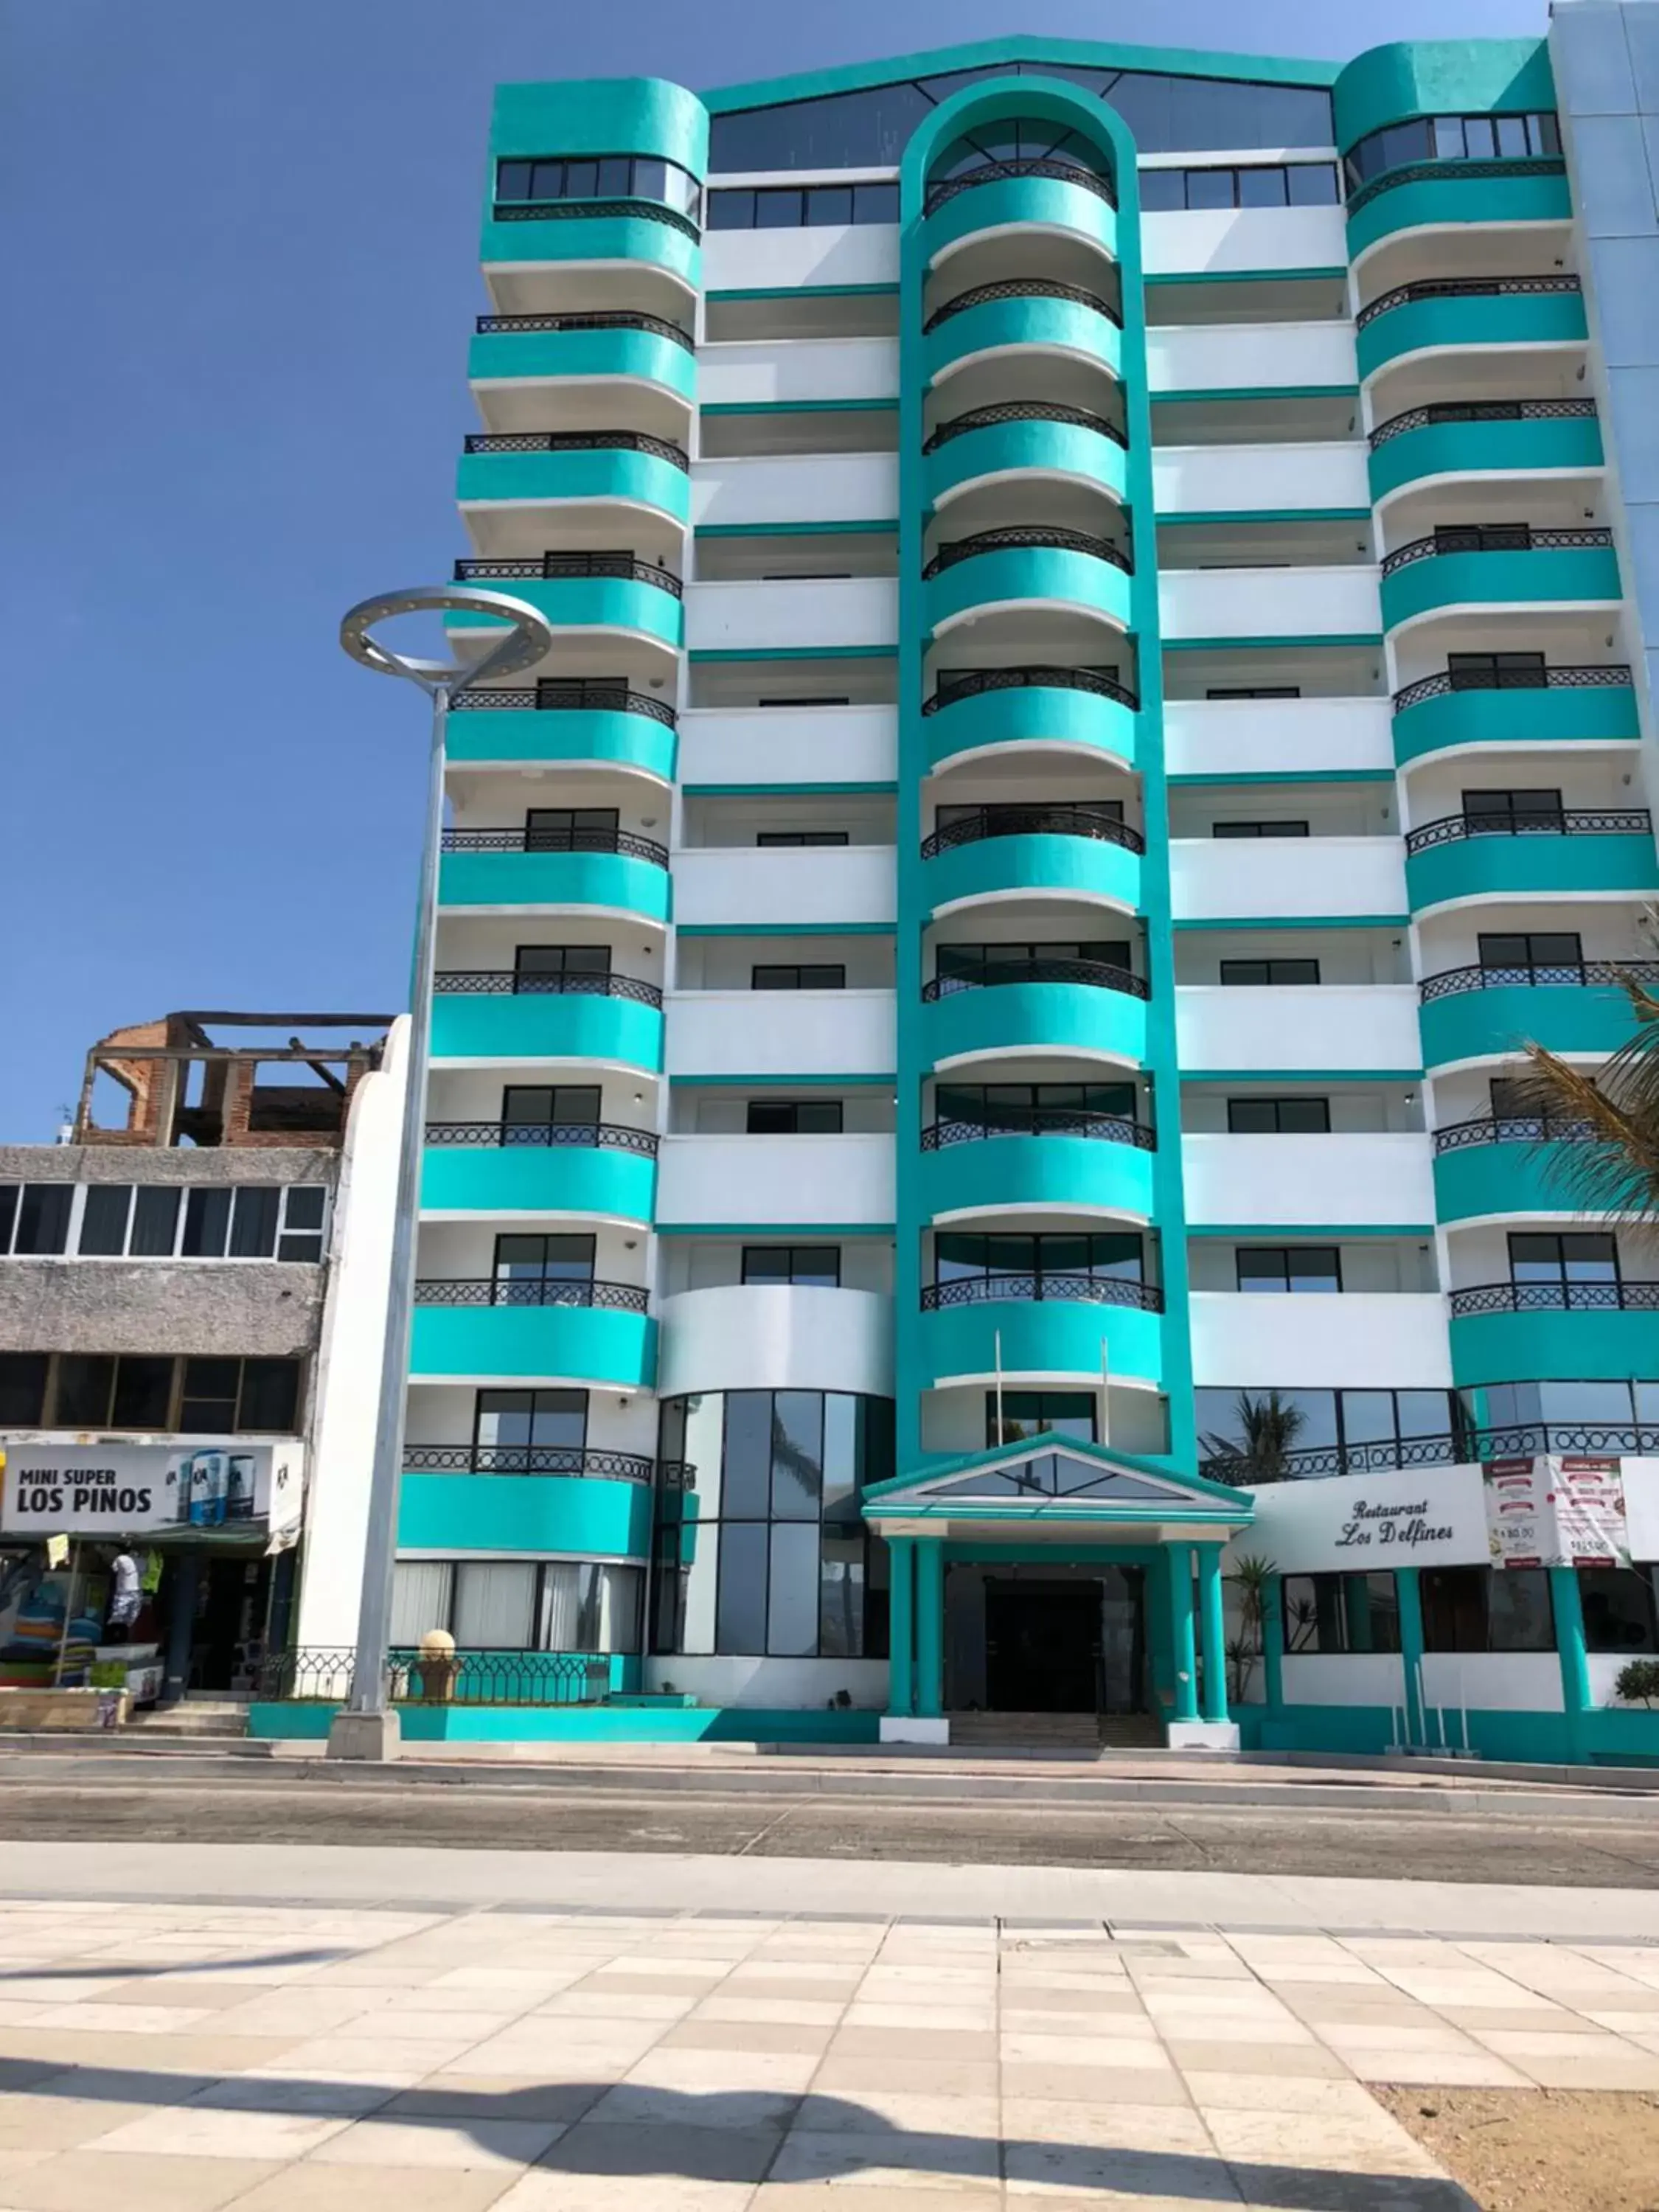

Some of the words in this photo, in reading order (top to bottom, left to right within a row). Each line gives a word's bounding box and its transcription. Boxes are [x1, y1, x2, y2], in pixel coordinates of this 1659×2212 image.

[20, 1470, 58, 1484] MINI
[63, 1470, 116, 1485] SUPER
[17, 1488, 63, 1513] LOS
[73, 1488, 152, 1513] PINOS
[1352, 1499, 1427, 1519] Restaurant
[1335, 1523, 1371, 1546] Los
[1379, 1519, 1453, 1549] Delfines
